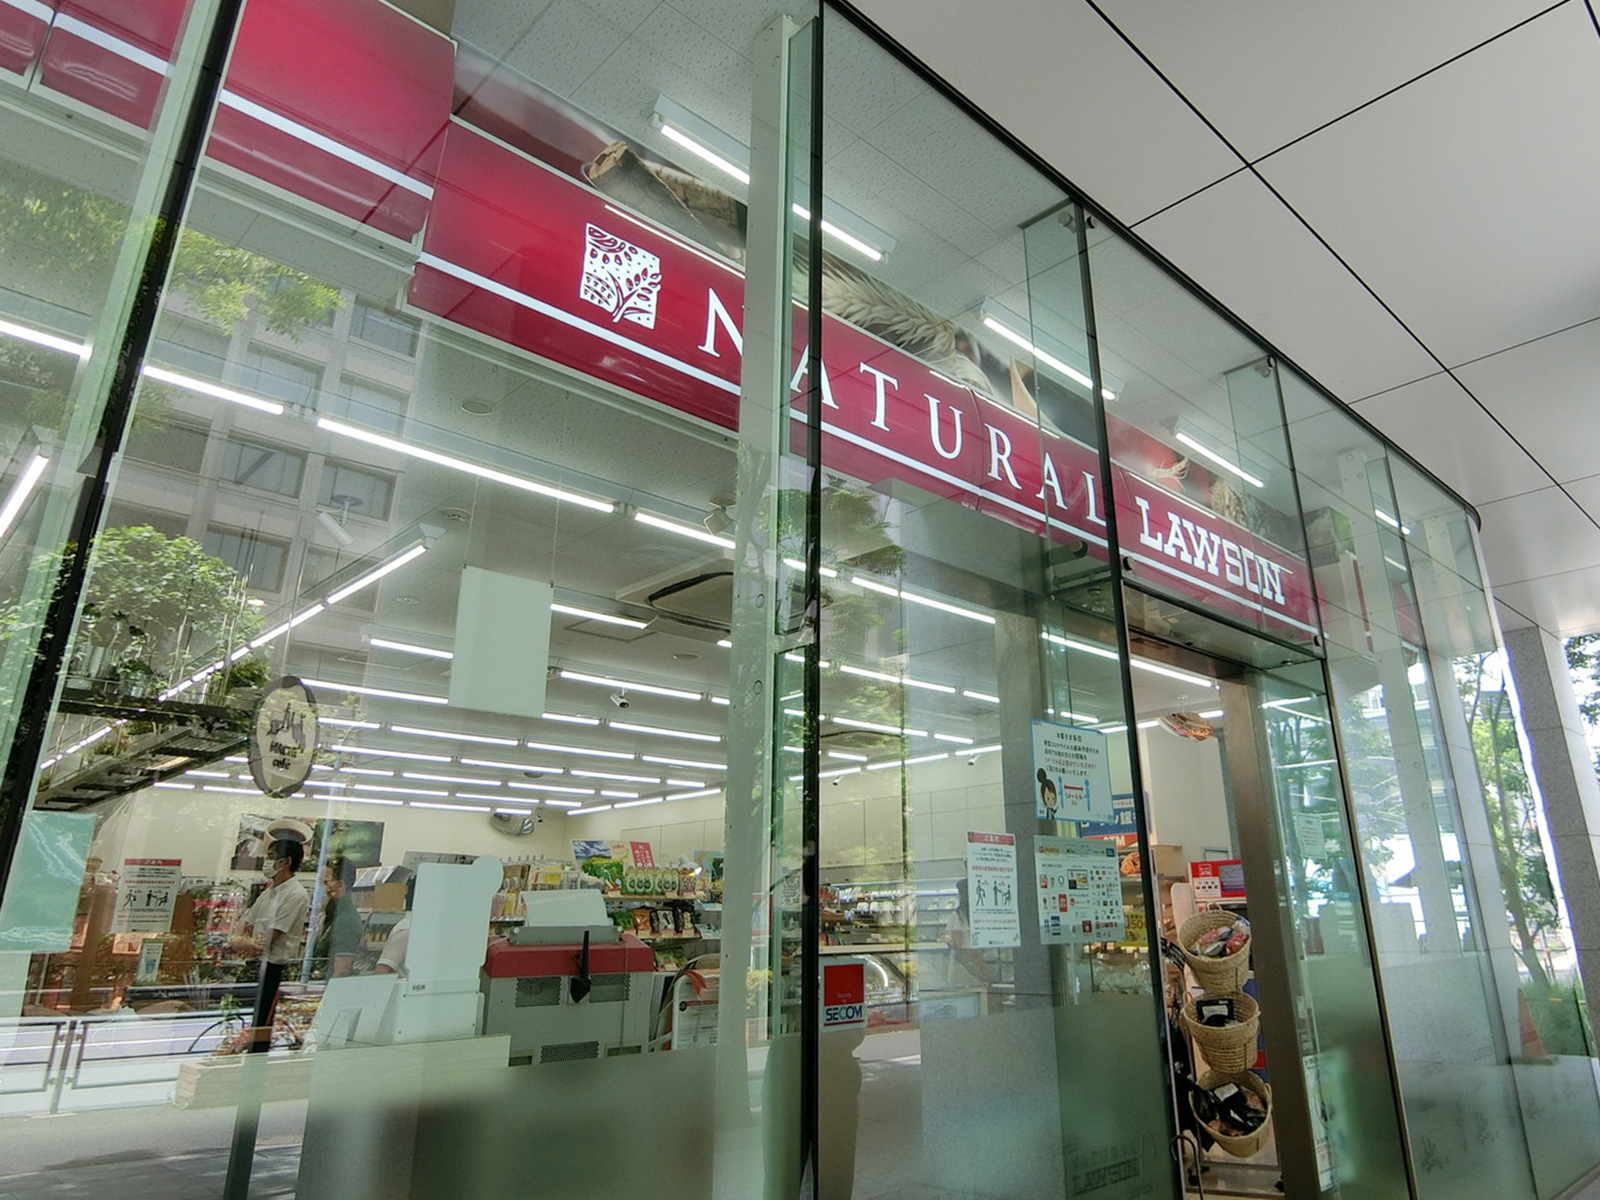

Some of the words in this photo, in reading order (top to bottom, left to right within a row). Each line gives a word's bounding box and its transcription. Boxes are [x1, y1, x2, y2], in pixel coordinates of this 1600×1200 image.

[698, 288, 1106, 525] NATURAL
[1135, 495, 1287, 605] LAWSON
[826, 1005, 863, 1022] SECOM
